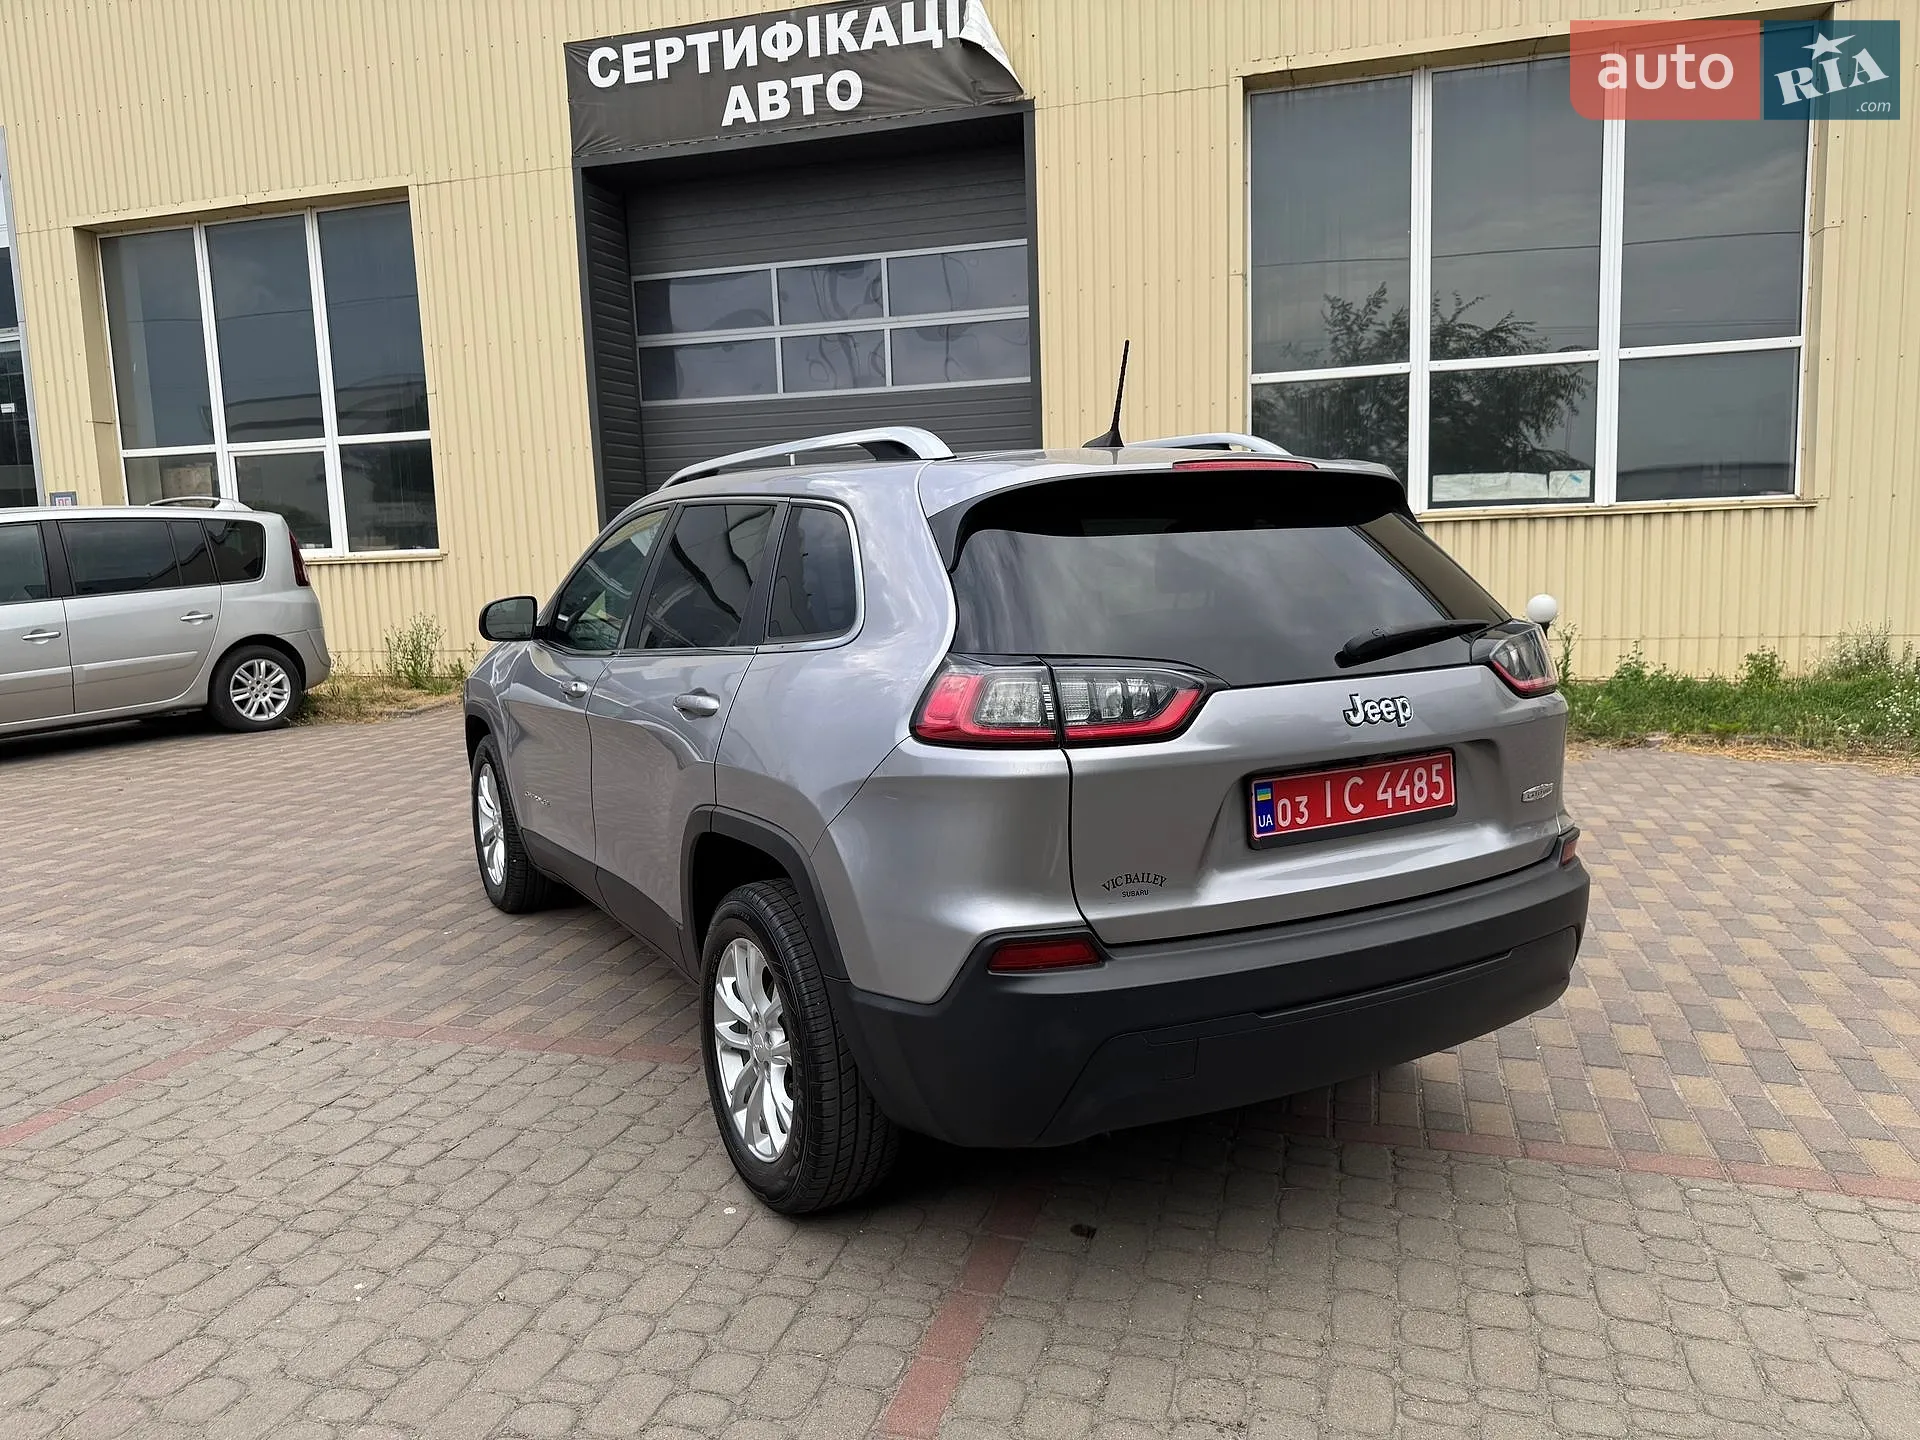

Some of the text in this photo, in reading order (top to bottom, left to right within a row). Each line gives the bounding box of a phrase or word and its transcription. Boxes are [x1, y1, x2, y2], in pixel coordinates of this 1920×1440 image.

[721, 69, 863, 127] АВТО
[1342, 692, 1414, 728] Jeep
[1277, 795, 1309, 827] 03
[1376, 763, 1445, 809] 4485
[1258, 813, 1274, 828] UA
[1101, 872, 1168, 892] VIC BAILEY
[1121, 889, 1150, 898] SUBARU
